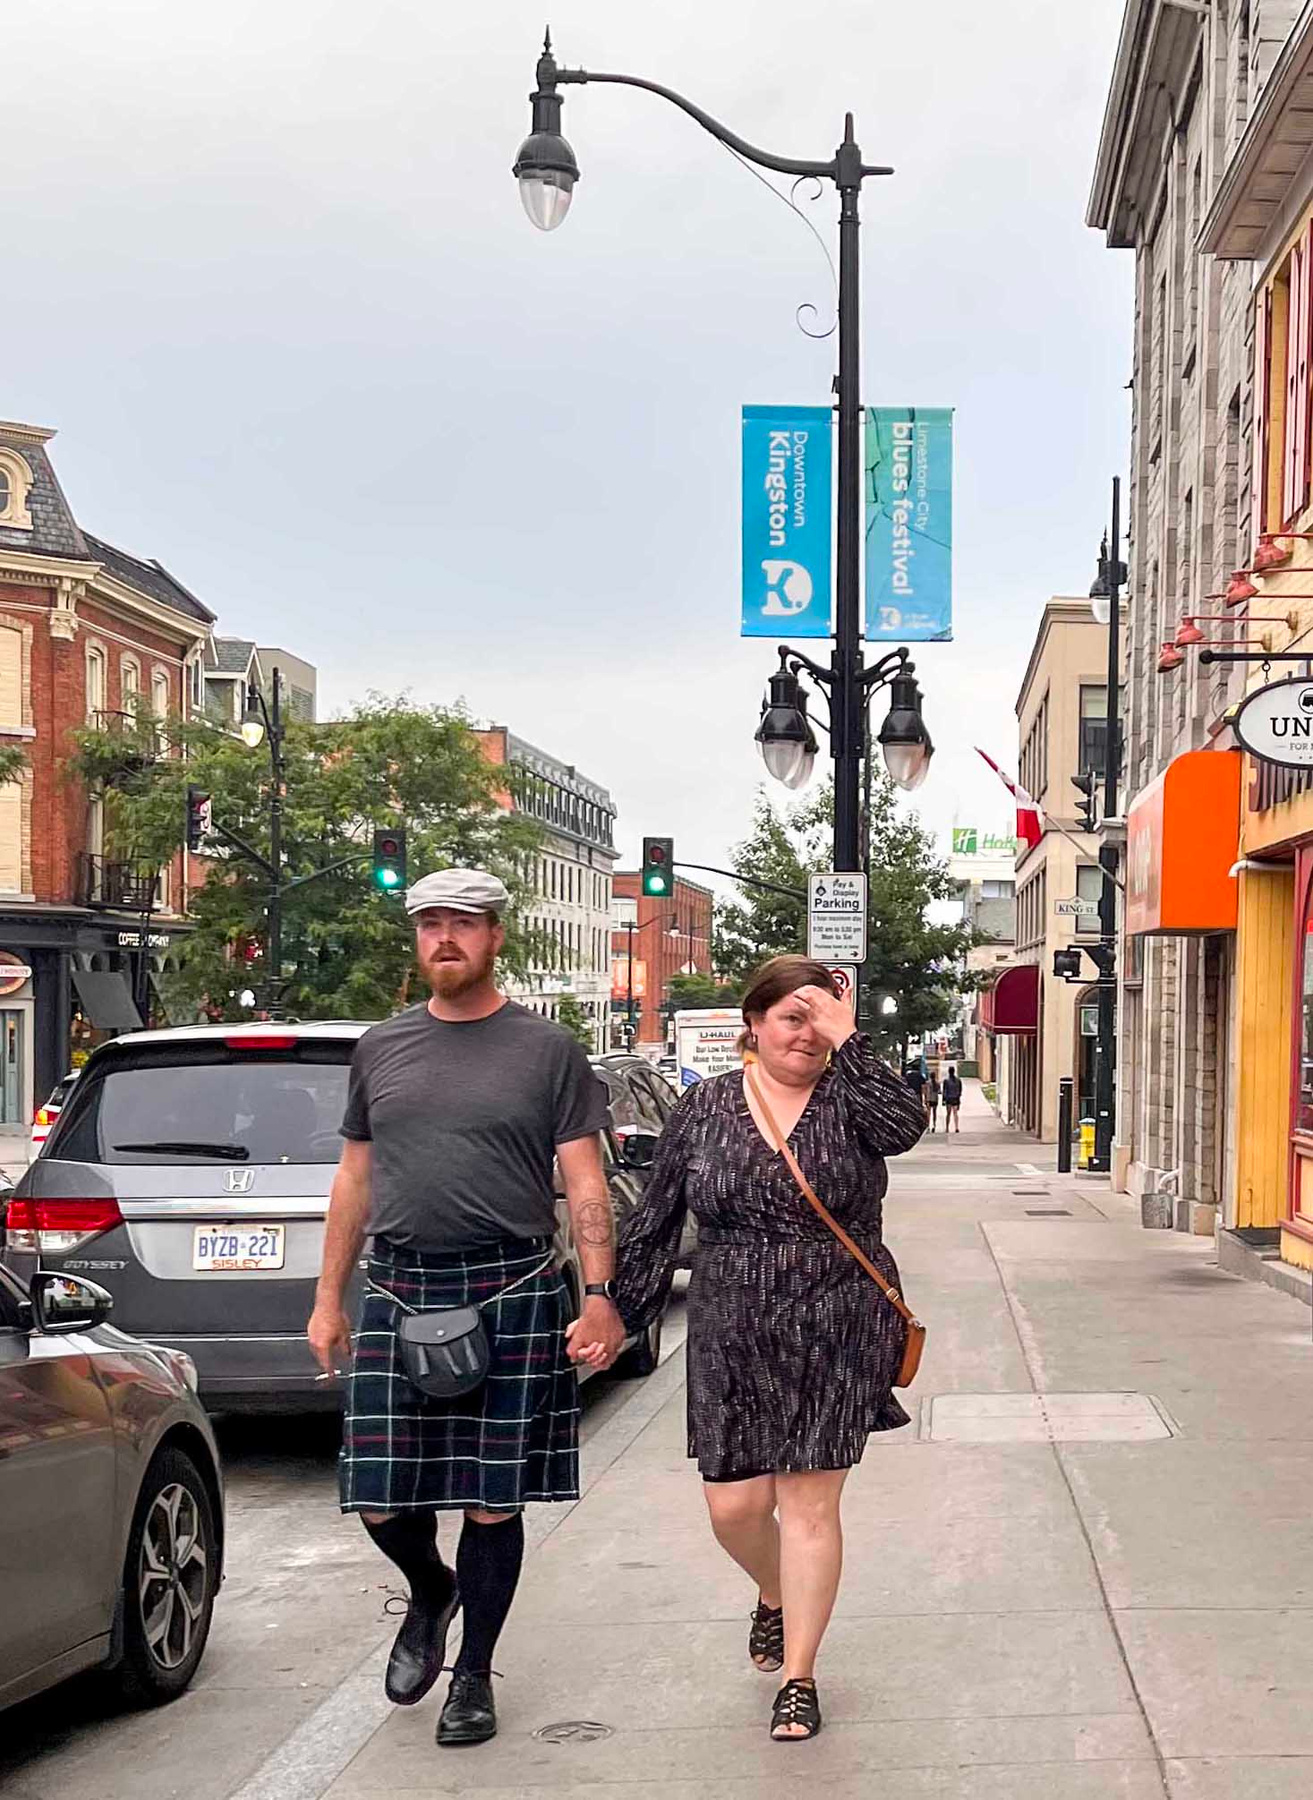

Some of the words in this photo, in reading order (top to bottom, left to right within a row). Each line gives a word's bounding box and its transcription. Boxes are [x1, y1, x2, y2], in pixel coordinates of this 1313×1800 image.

[892, 422, 914, 492] blues
[917, 422, 930, 498] Limestone
[765, 431, 791, 546] Kingston
[793, 432, 808, 527] Downtown
[914, 502, 930, 531] City
[892, 499, 915, 595] festival
[1289, 742, 1308, 750] FOR
[833, 880, 846, 888] Pay
[814, 898, 859, 910] Parking
[1058, 904, 1083, 912] KING
[118, 932, 140, 947] COFFEE
[199, 1236, 239, 1257] BYZB
[249, 1235, 278, 1256] 221
[63, 1260, 129, 1269] ODYSSEY
[212, 1259, 262, 1269] SISLEY
